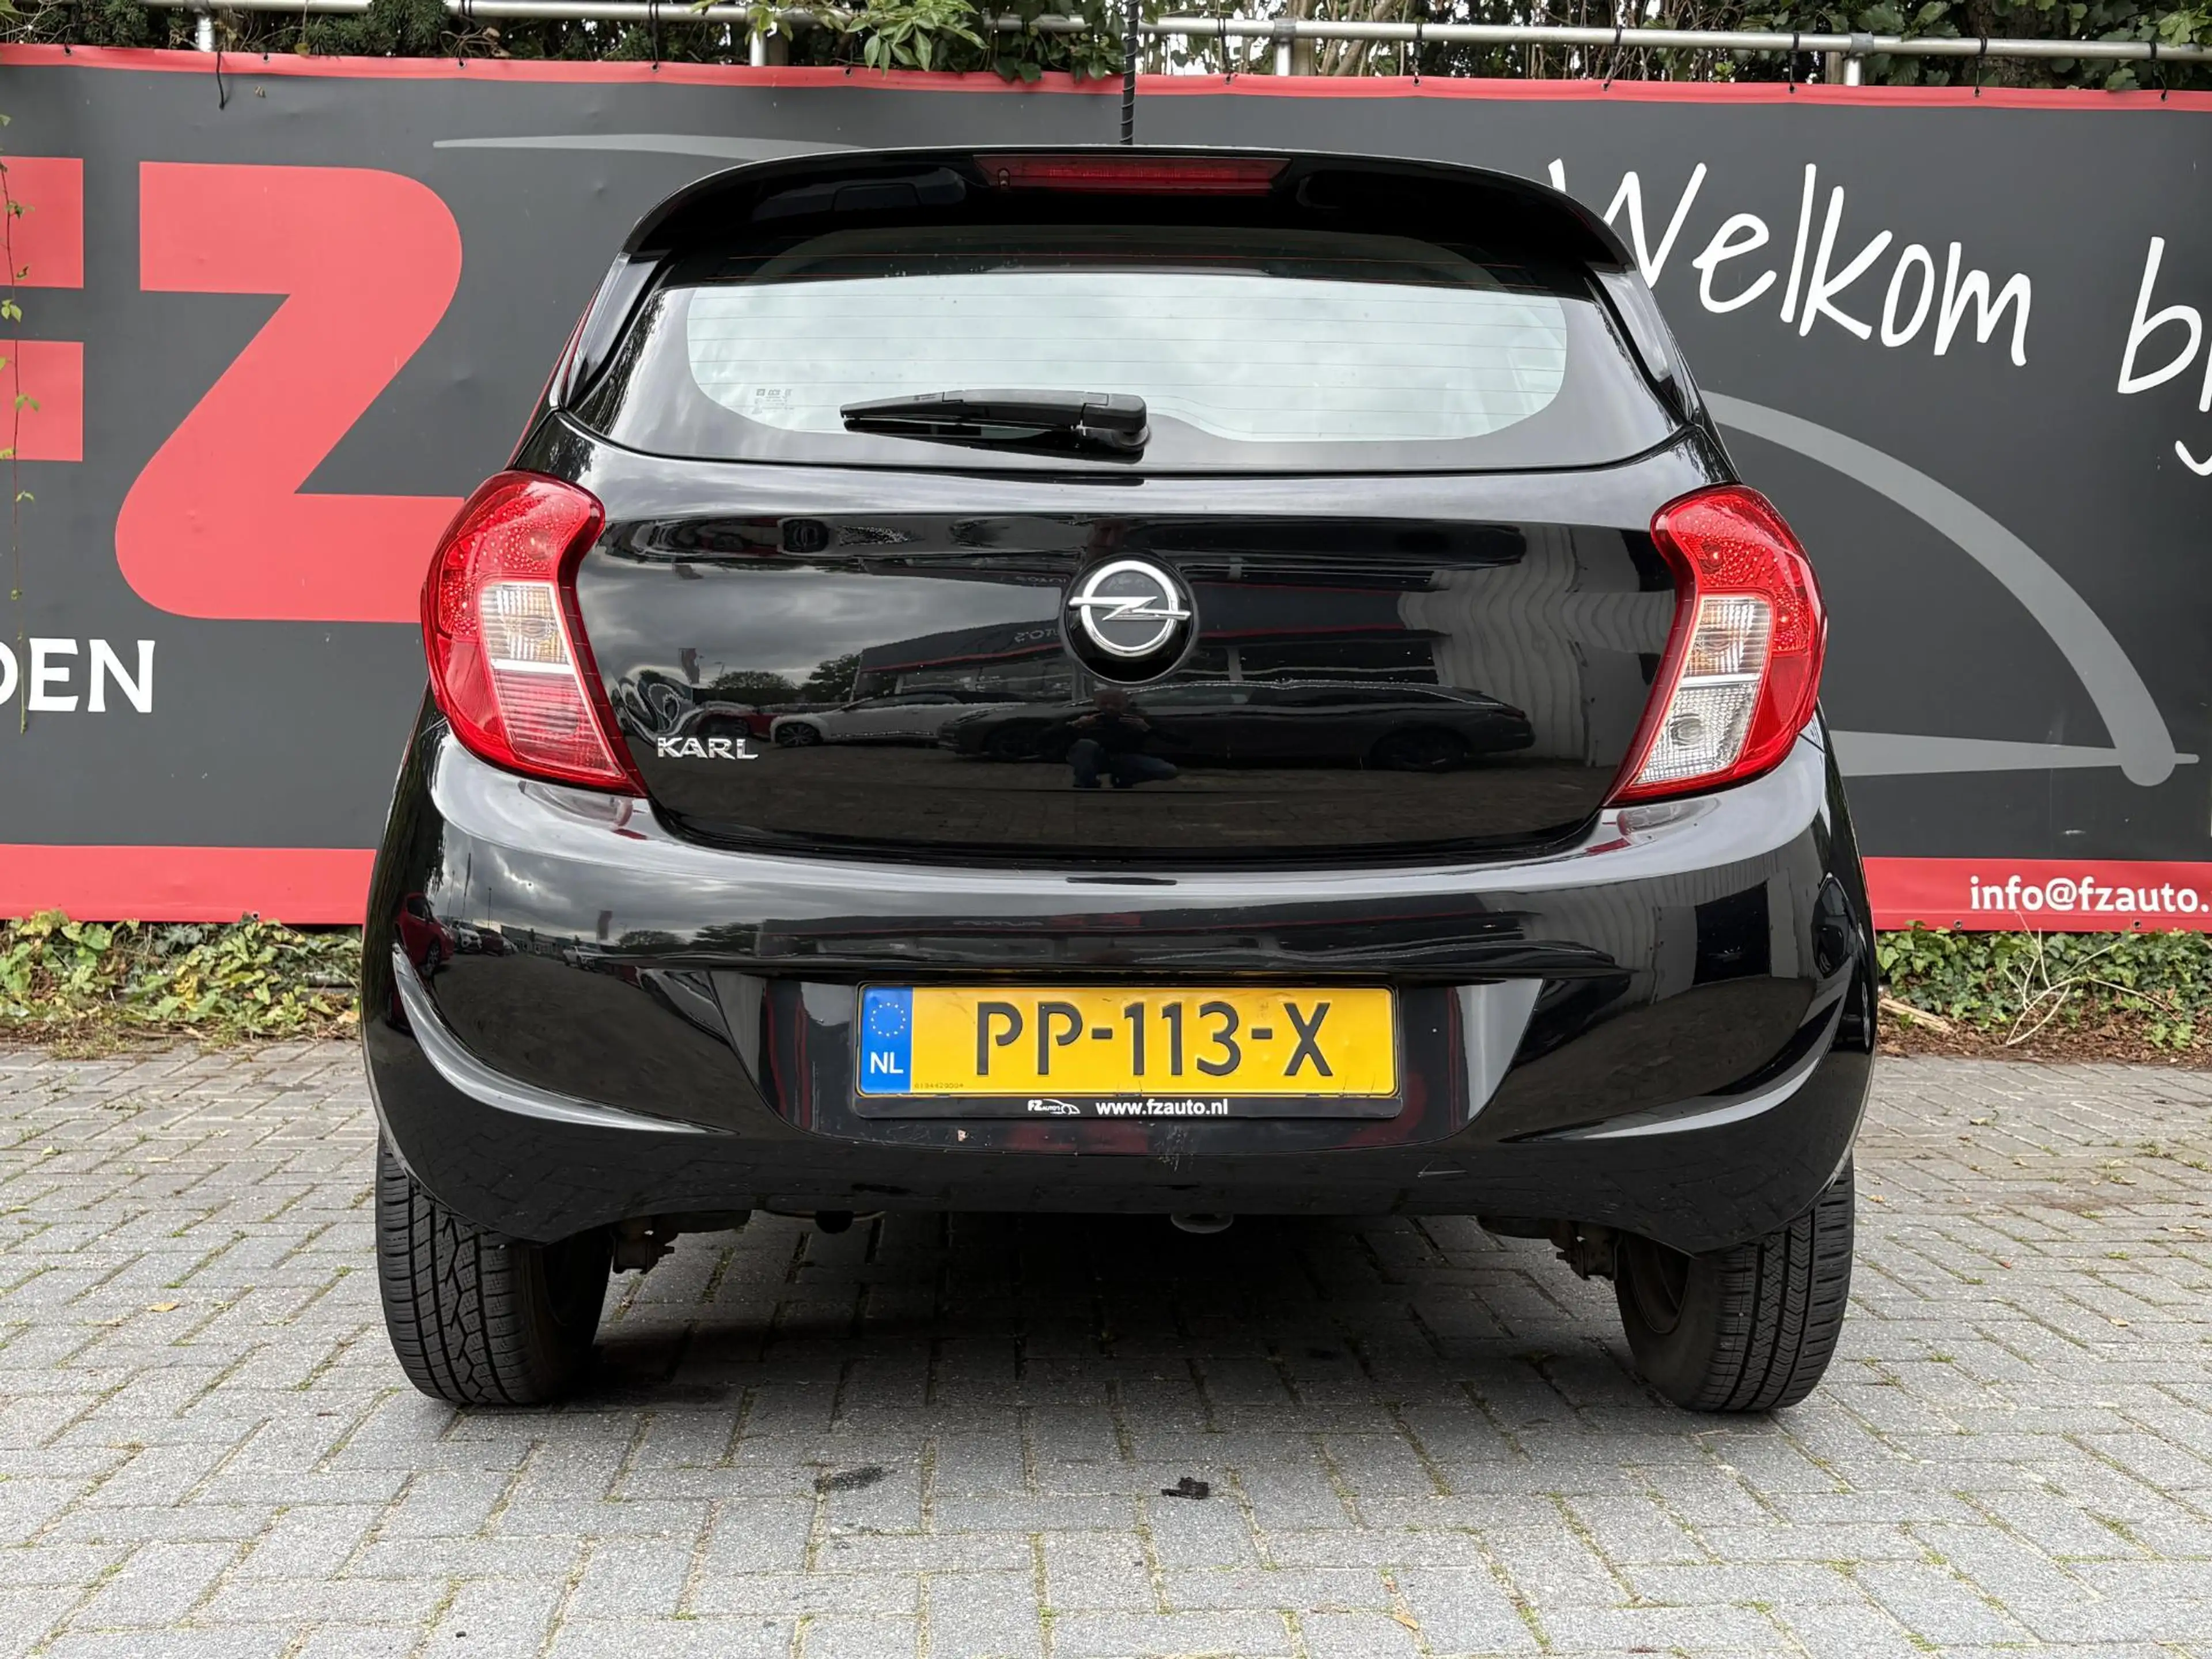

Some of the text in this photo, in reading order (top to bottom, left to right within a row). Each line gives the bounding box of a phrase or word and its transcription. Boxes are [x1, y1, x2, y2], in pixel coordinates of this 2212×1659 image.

[1548, 158, 2031, 366] Welkom
[657, 737, 759, 760] KARL
[1970, 875, 2212, 912] info@fzauto.
[976, 1001, 1333, 1077] PP-113-X
[870, 1052, 903, 1074] NL
[1028, 1099, 1043, 1111] FZ
[1096, 1099, 1228, 1115] www.fzauto.nl
